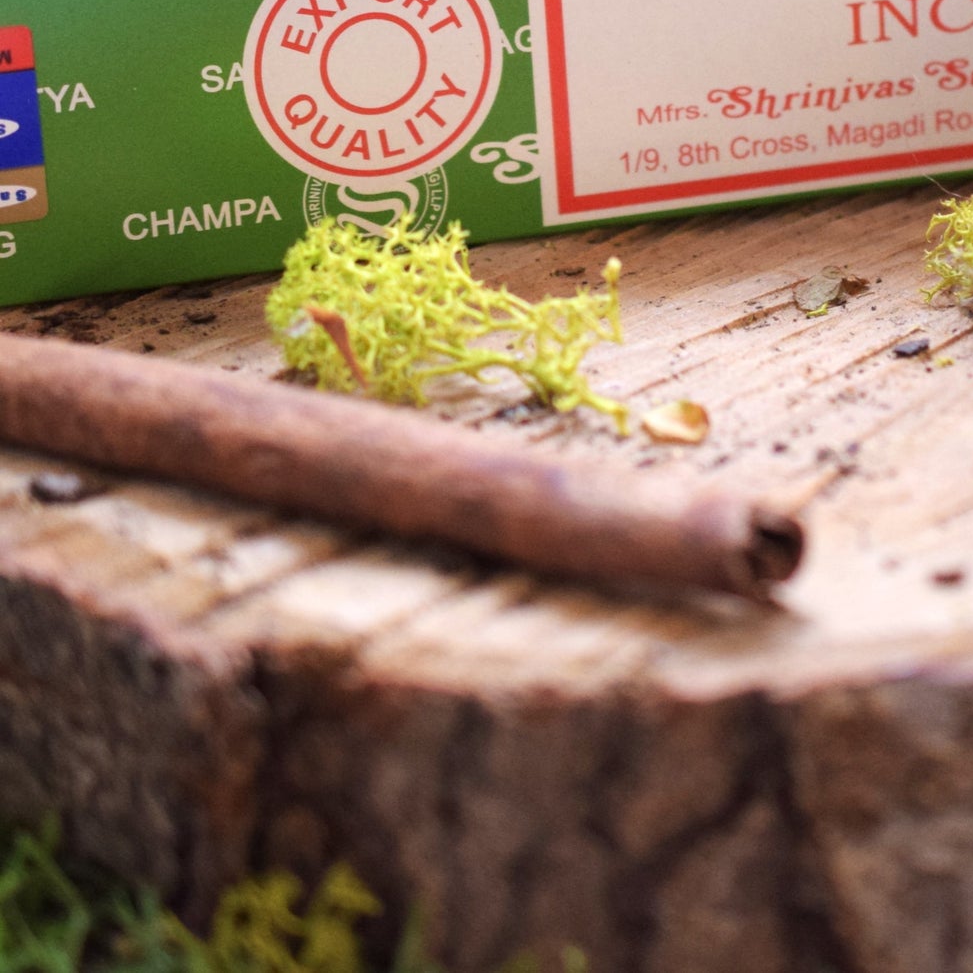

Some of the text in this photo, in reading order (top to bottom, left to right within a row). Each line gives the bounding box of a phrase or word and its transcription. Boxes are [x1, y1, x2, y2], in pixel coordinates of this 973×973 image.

[284, 73, 467, 161] QUALITY
[619, 147, 668, 174] 1/9,
[678, 141, 721, 167] 8th
[729, 133, 818, 160] Cross,
[826, 113, 926, 147] Magadi
[122, 196, 282, 240] CHAMPA
